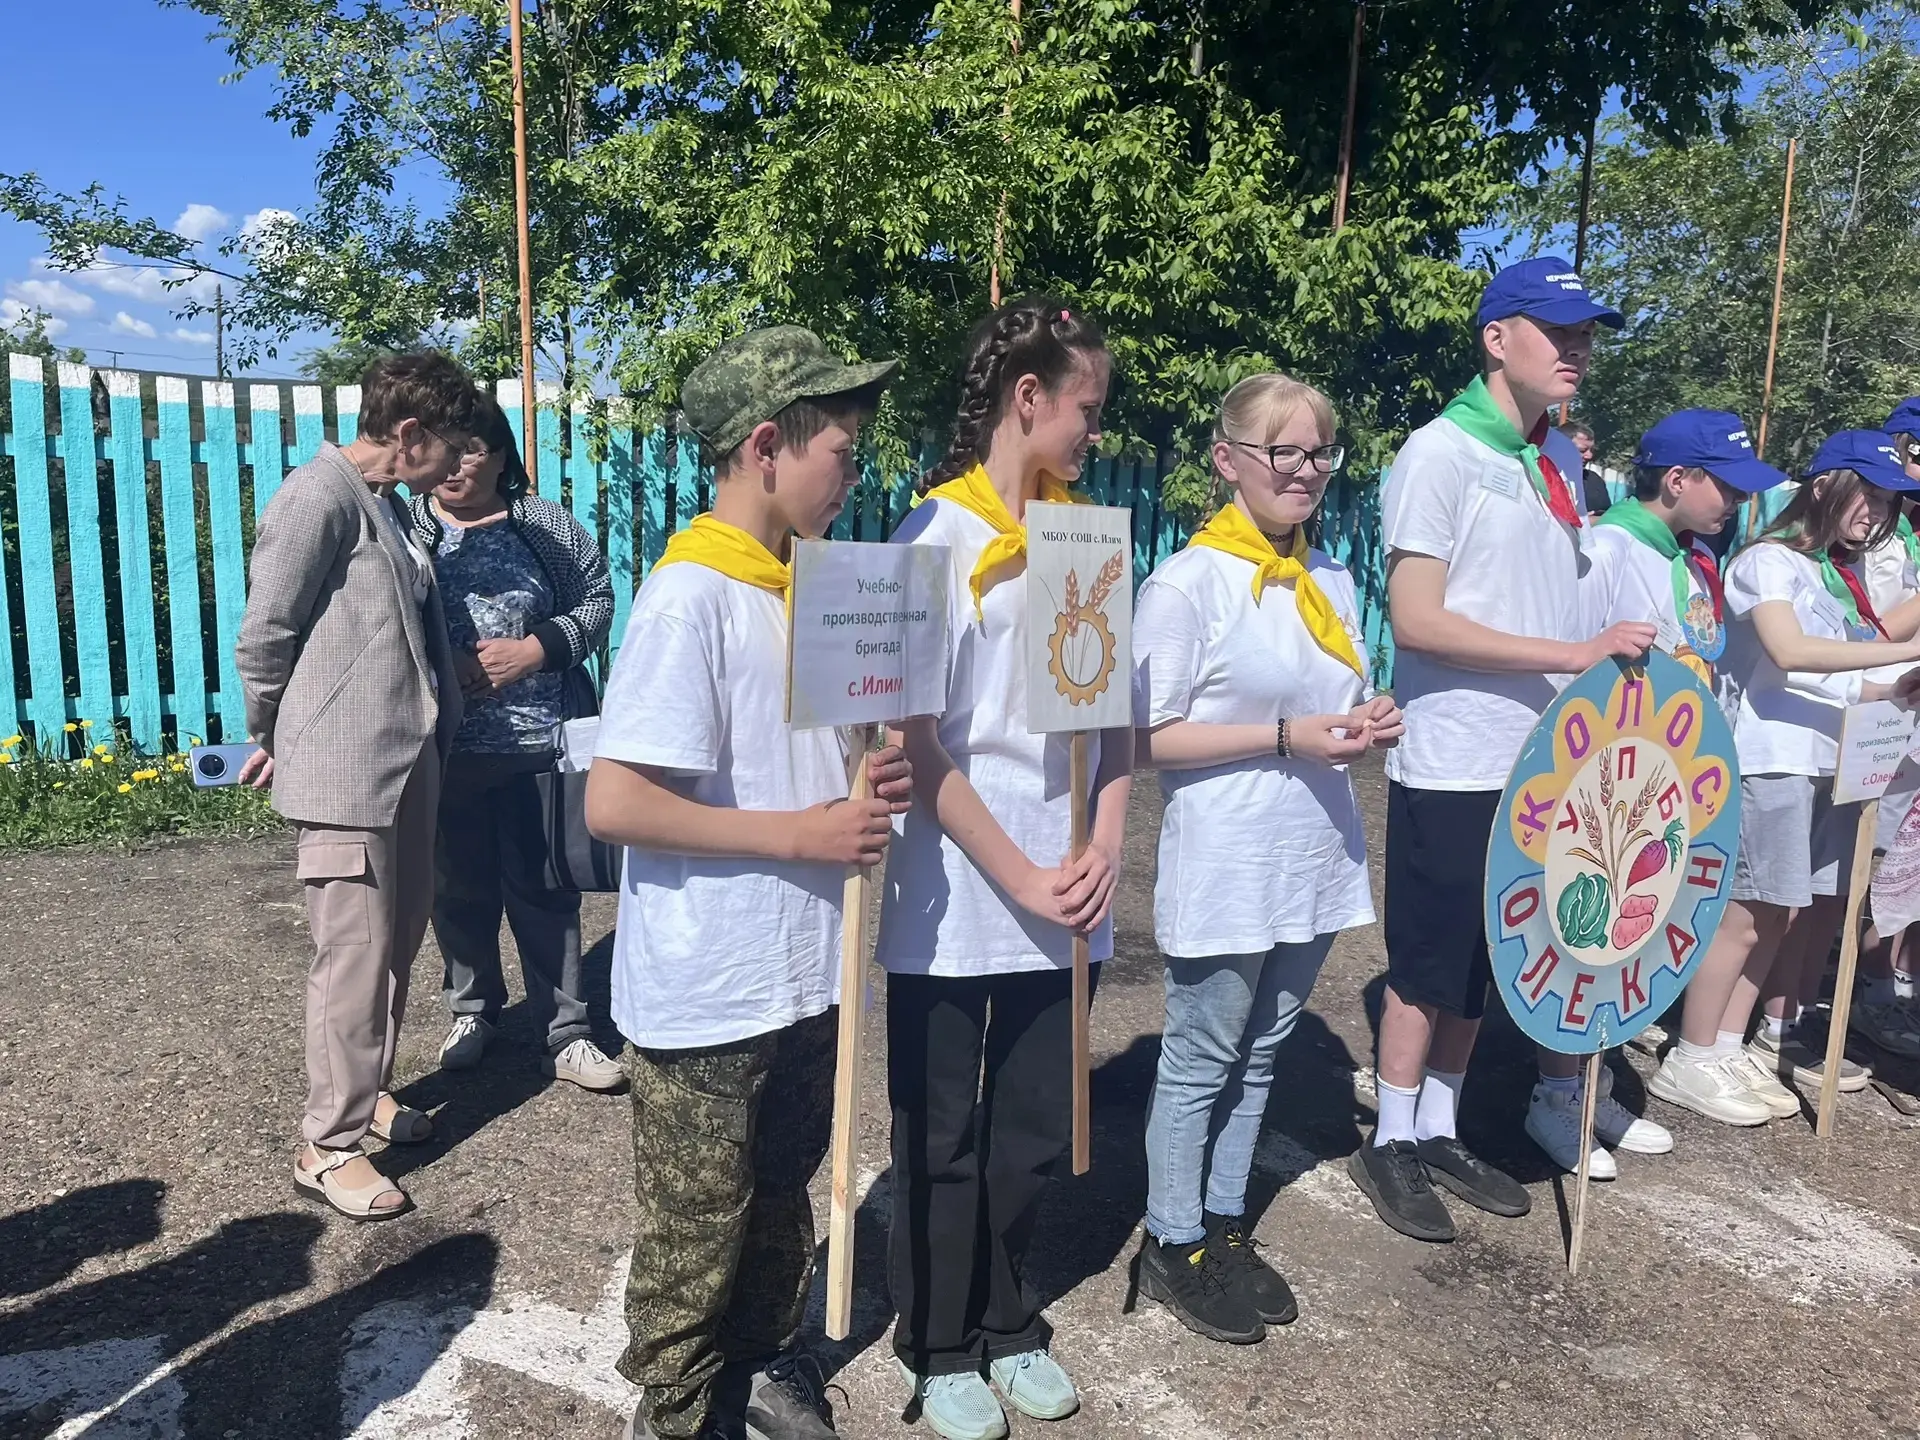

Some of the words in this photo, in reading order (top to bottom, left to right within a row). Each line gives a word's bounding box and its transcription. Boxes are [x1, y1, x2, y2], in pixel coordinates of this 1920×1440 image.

[1041, 531, 1068, 542] МБОУ
[1070, 532, 1092, 543] СОШ
[1093, 536, 1100, 544] с.
[1101, 534, 1122, 544] Илим
[857, 578, 902, 593] Учебно-
[822, 610, 927, 628] производственная
[855, 639, 901, 658] бригада
[848, 675, 904, 697] с.Илим
[1876, 718, 1903, 729] Учебно-
[1872, 752, 1900, 763] бригада
[1862, 770, 1904, 786] с.Олекан
[1504, 856, 1722, 1025] ОЛЕКАН
